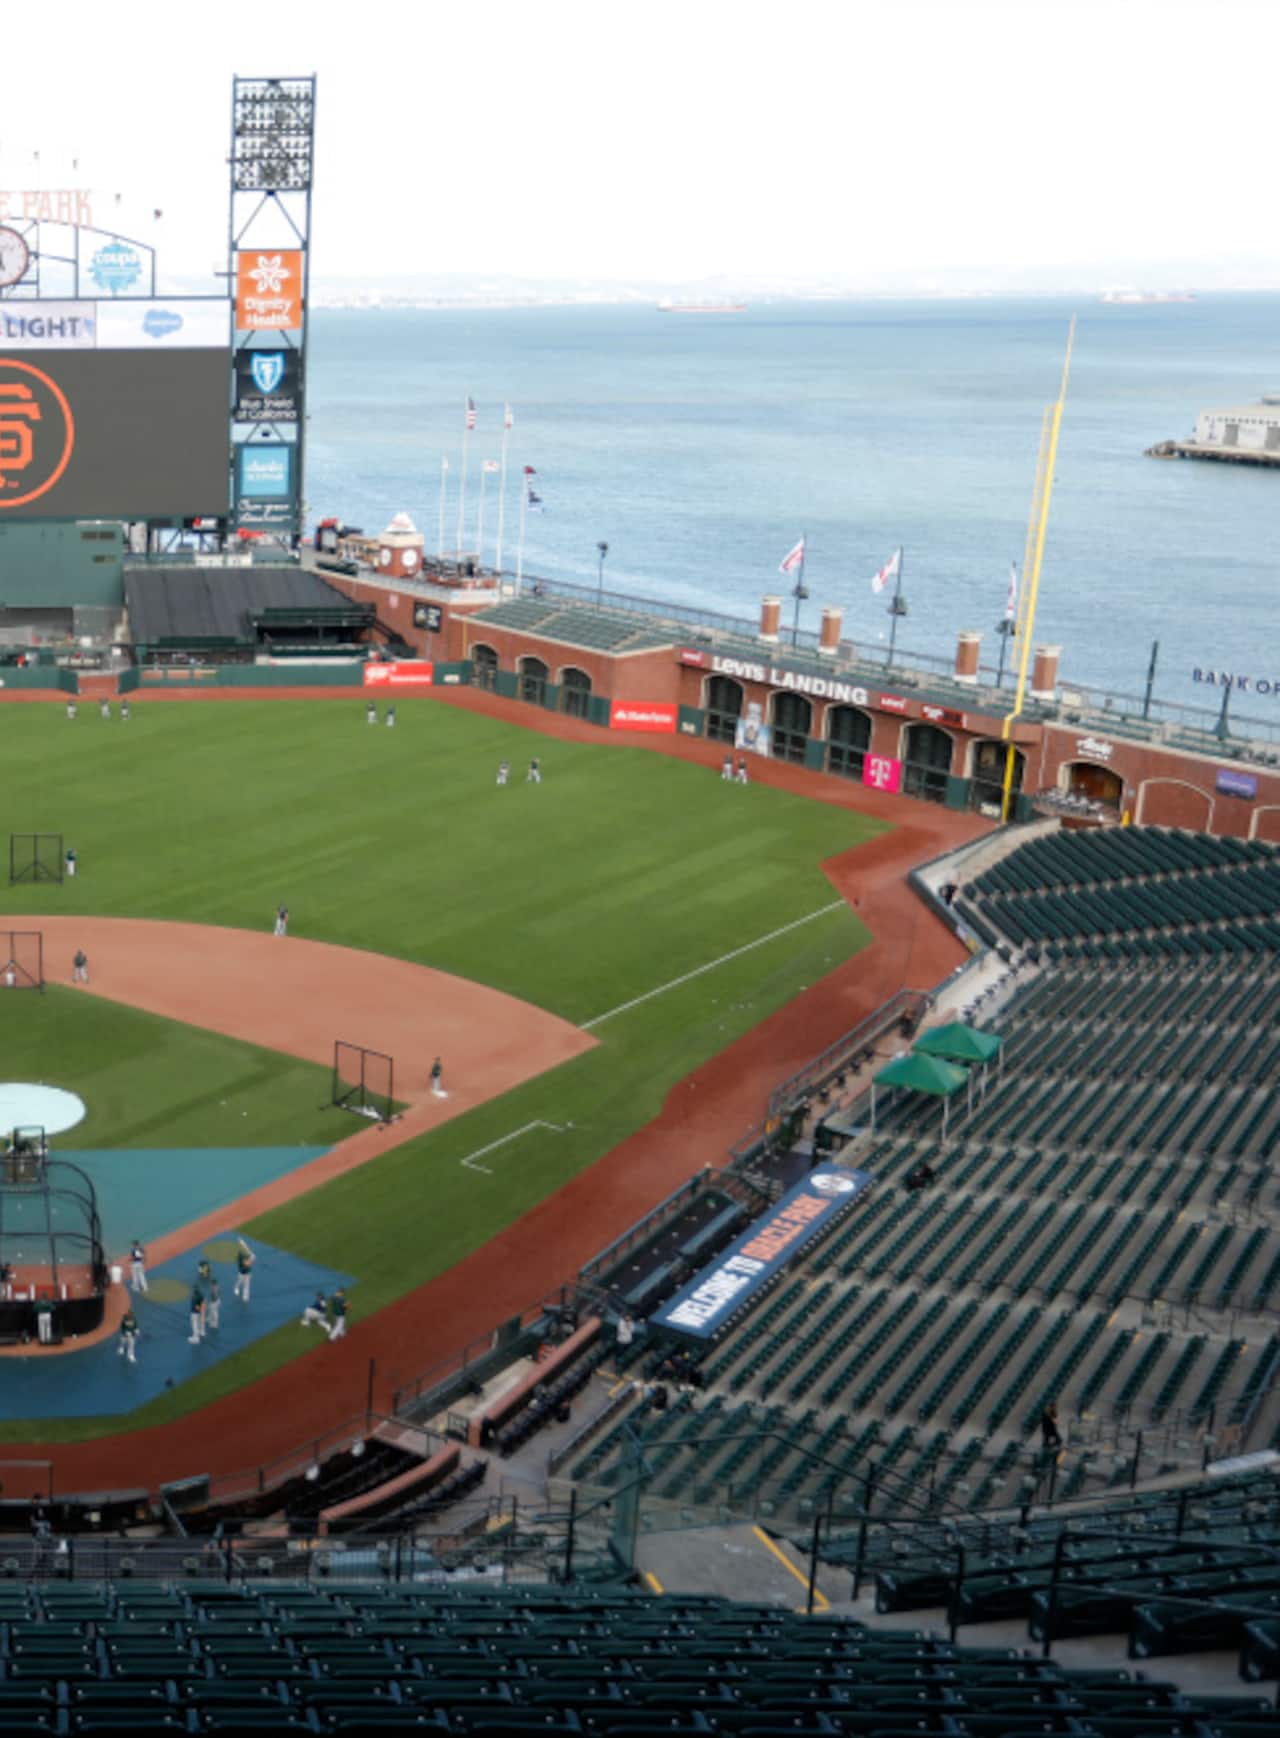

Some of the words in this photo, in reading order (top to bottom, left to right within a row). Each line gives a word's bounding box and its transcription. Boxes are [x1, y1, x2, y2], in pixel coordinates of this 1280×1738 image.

[23, 190, 93, 227] PARK
[4, 316, 81, 338] LIGHT
[770, 667, 868, 706] LANDING
[1193, 667, 1248, 691] BANK
[869, 757, 891, 788] T
[666, 1270, 750, 1328] WELCOME
[723, 1255, 765, 1276] TO
